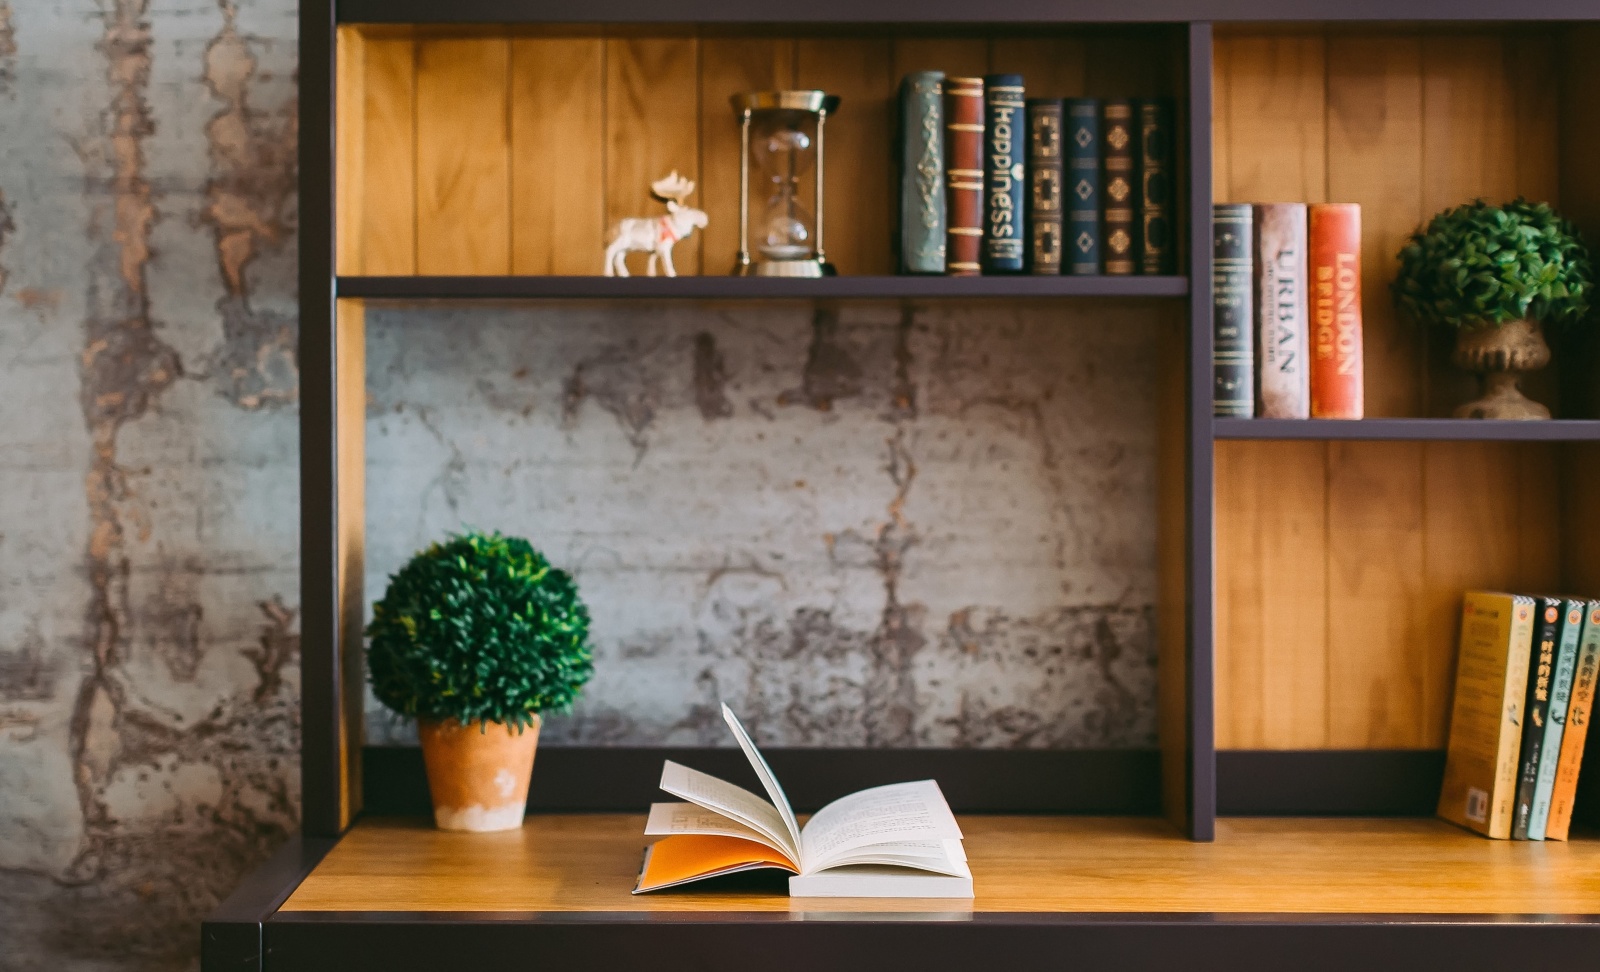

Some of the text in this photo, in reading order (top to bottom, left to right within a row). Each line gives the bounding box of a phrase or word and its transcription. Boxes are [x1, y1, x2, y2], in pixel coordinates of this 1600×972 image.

[990, 106, 1015, 238] Happiness
[1277, 250, 1295, 373] URBAN
[1316, 266, 1334, 360] BRIDGE
[1336, 253, 1356, 376] LONDON
